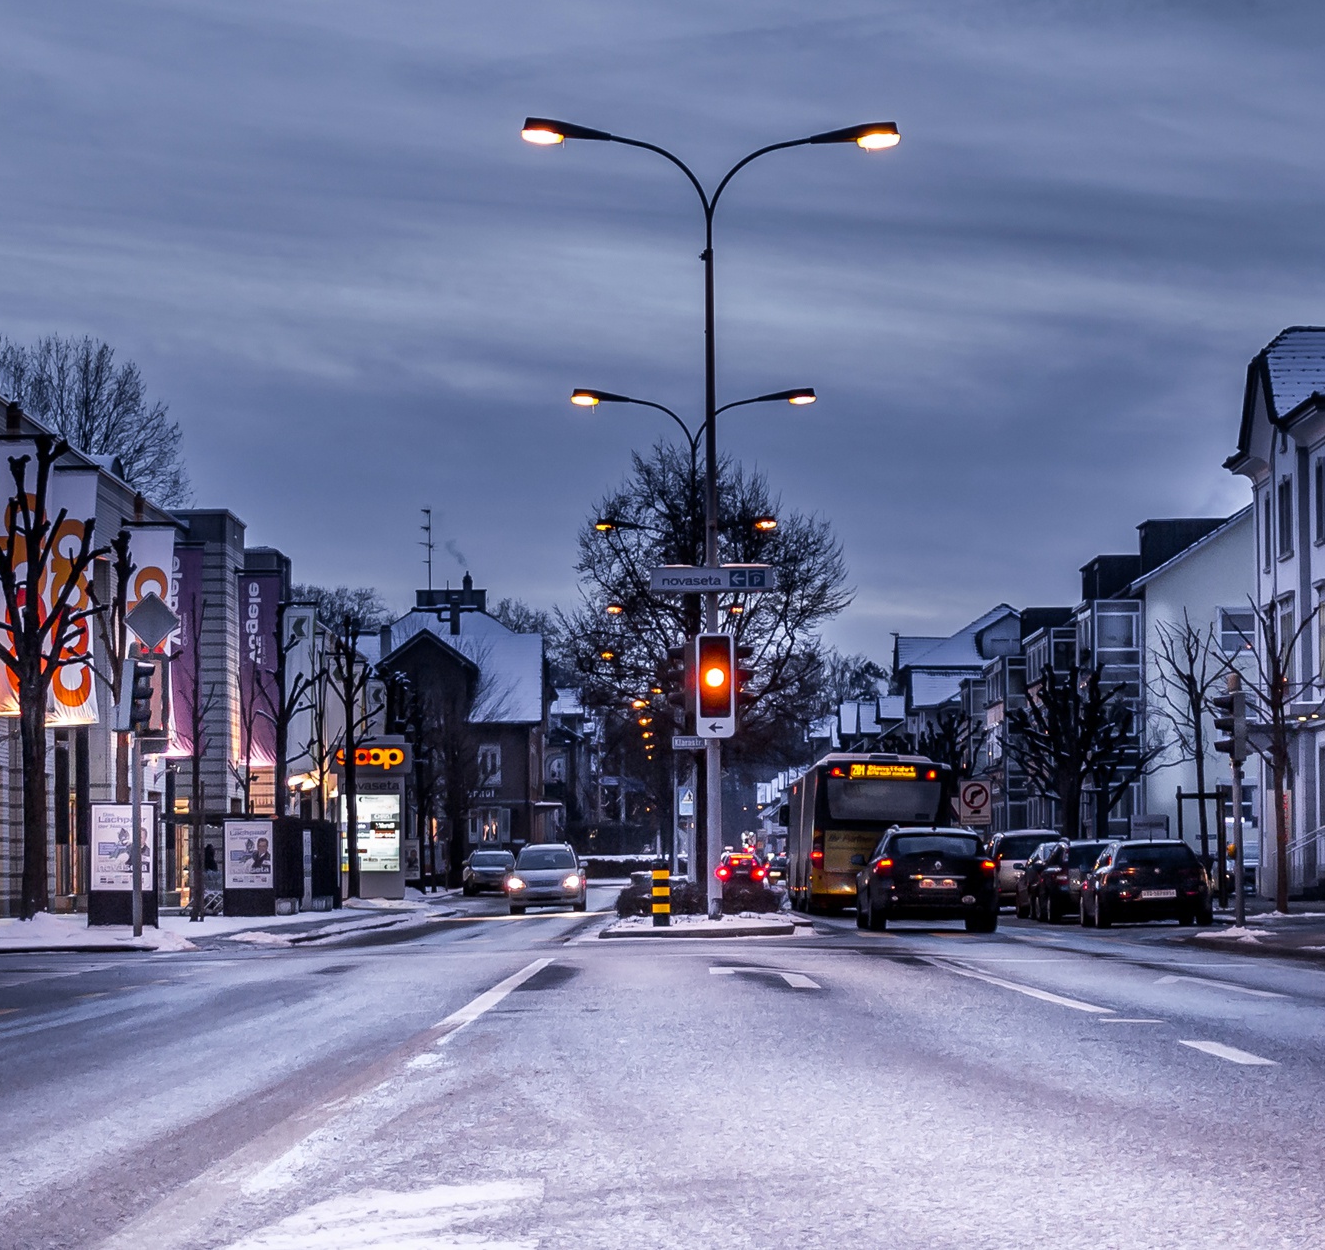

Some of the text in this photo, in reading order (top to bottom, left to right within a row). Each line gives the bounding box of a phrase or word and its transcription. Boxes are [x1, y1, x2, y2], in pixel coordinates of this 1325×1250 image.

[662, 575, 722, 586] novaseta
[342, 780, 400, 790] vaseta
[98, 816, 147, 824] Lachpr
